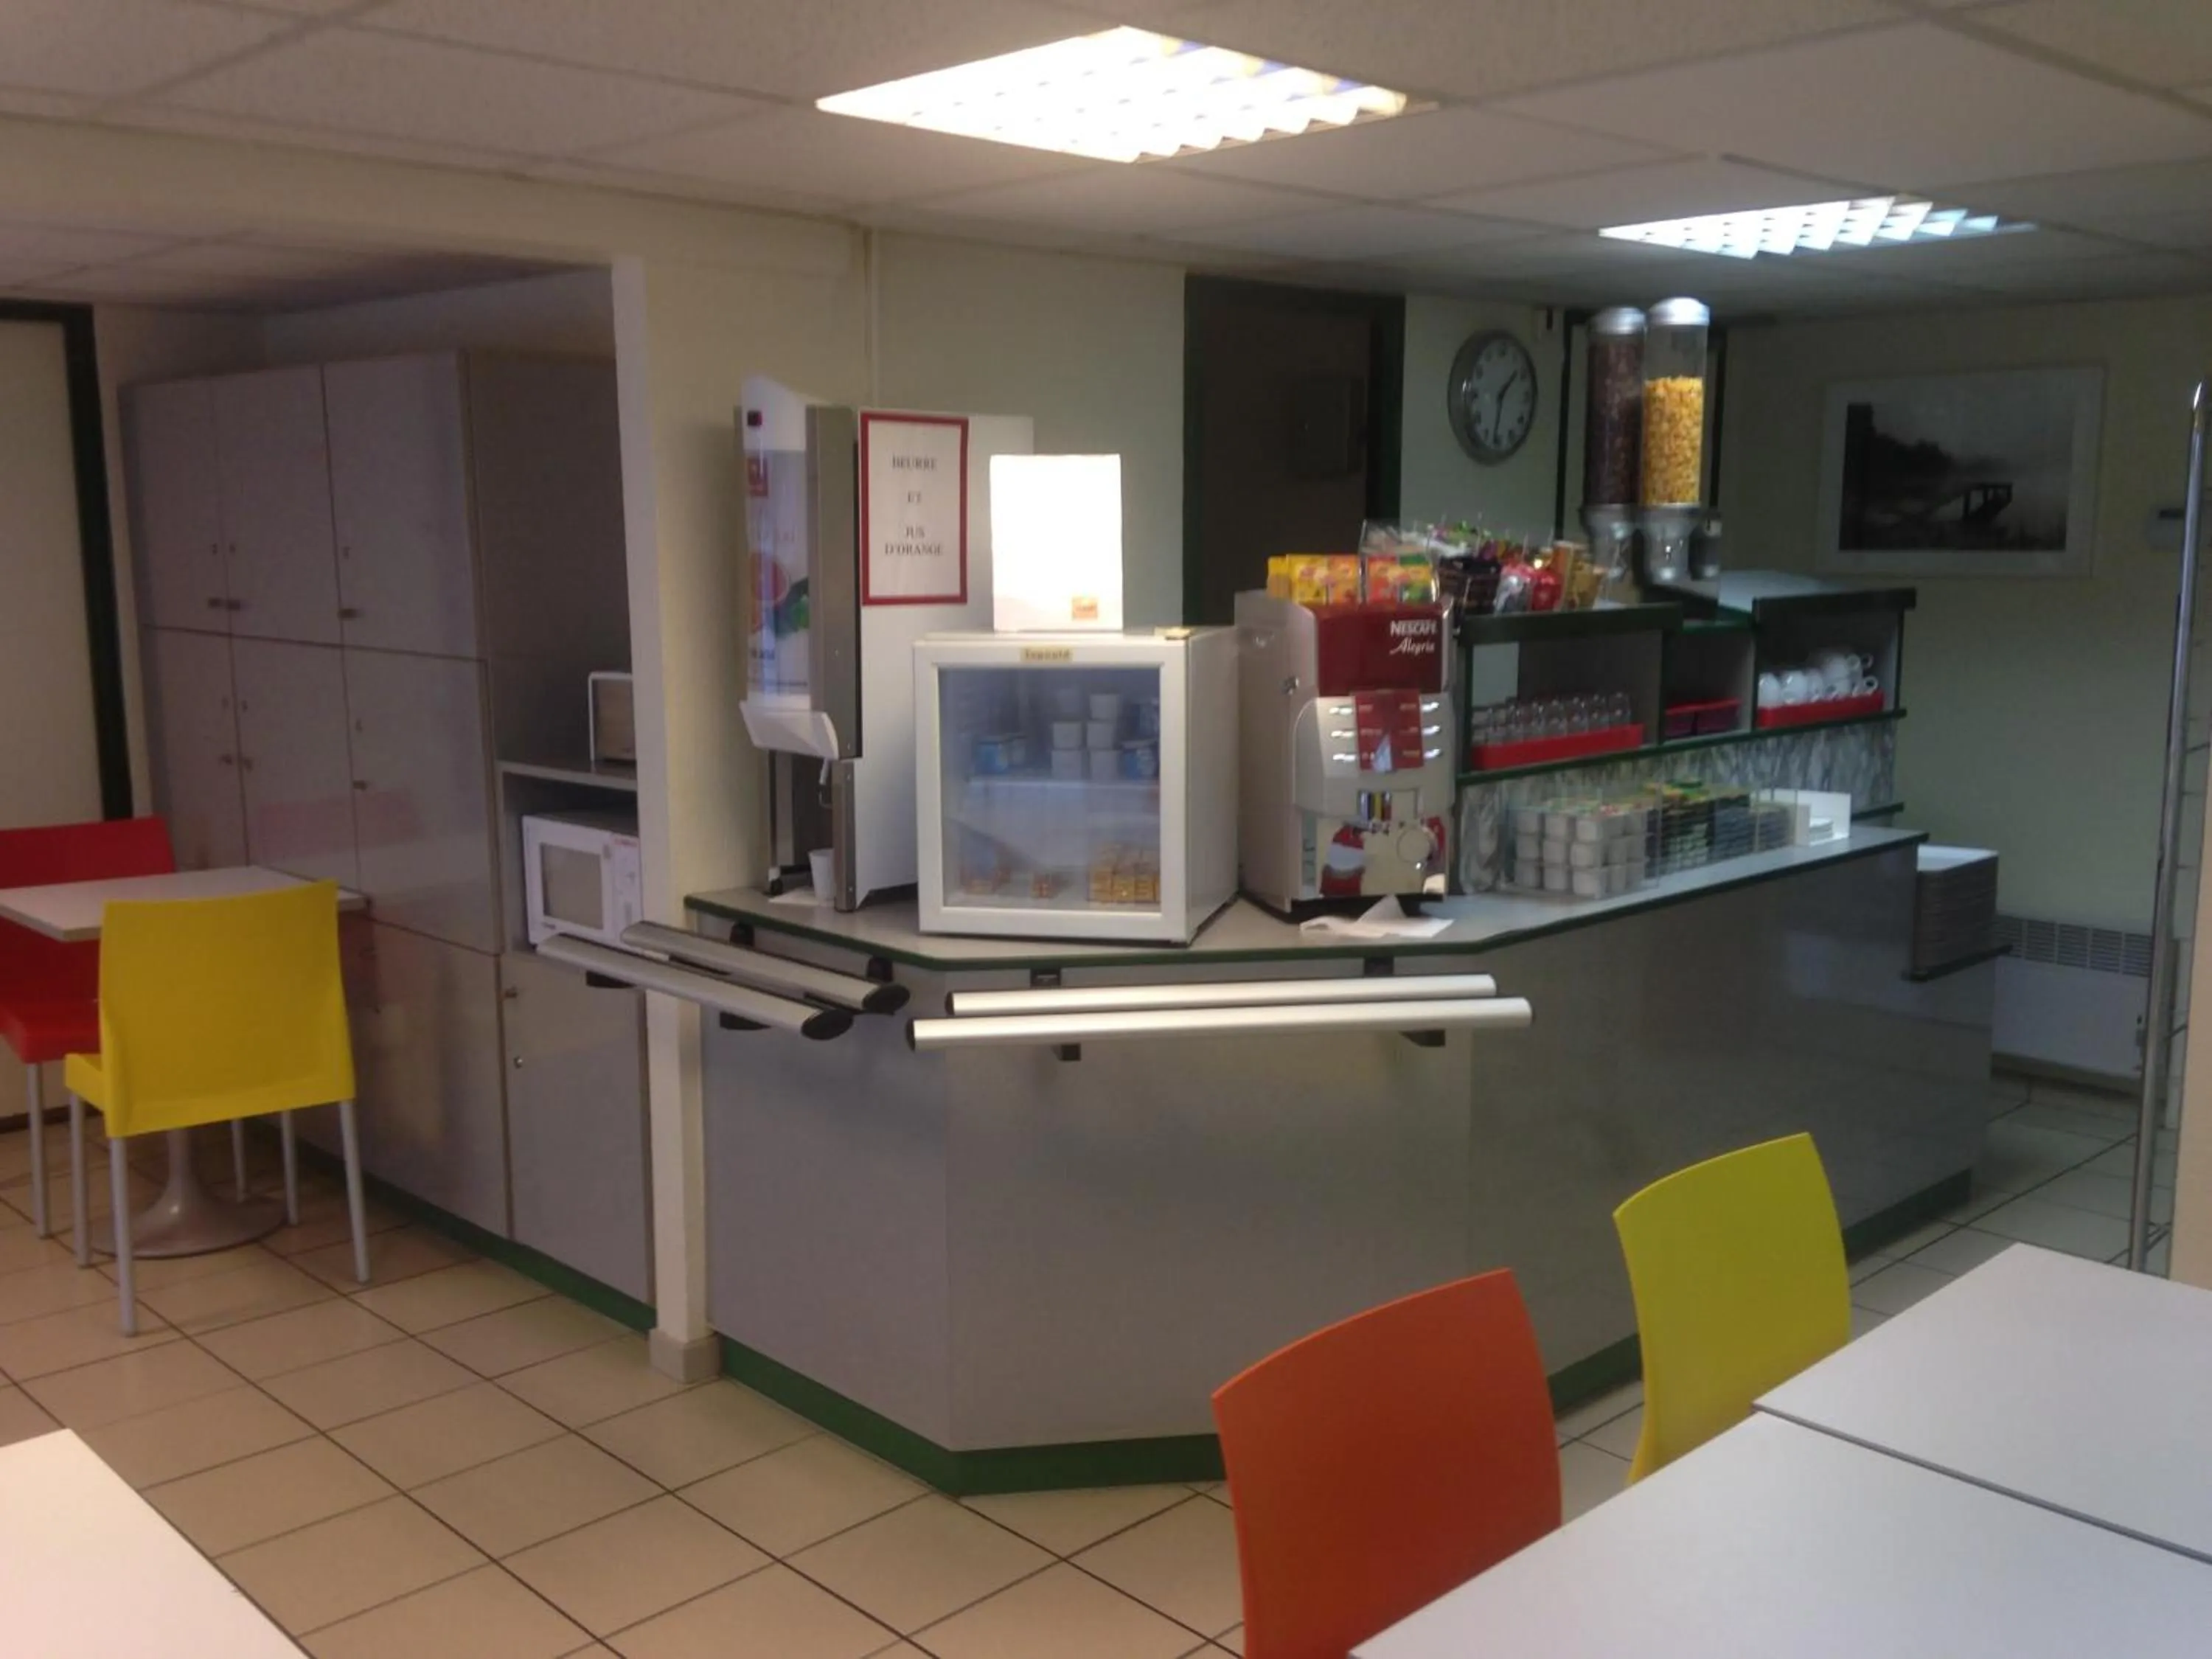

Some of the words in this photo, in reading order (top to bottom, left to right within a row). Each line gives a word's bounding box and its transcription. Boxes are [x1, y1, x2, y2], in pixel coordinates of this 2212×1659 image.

[892, 454, 937, 470] BEURRE
[907, 490, 922, 503] ET
[885, 542, 943, 556] D'ORANGE
